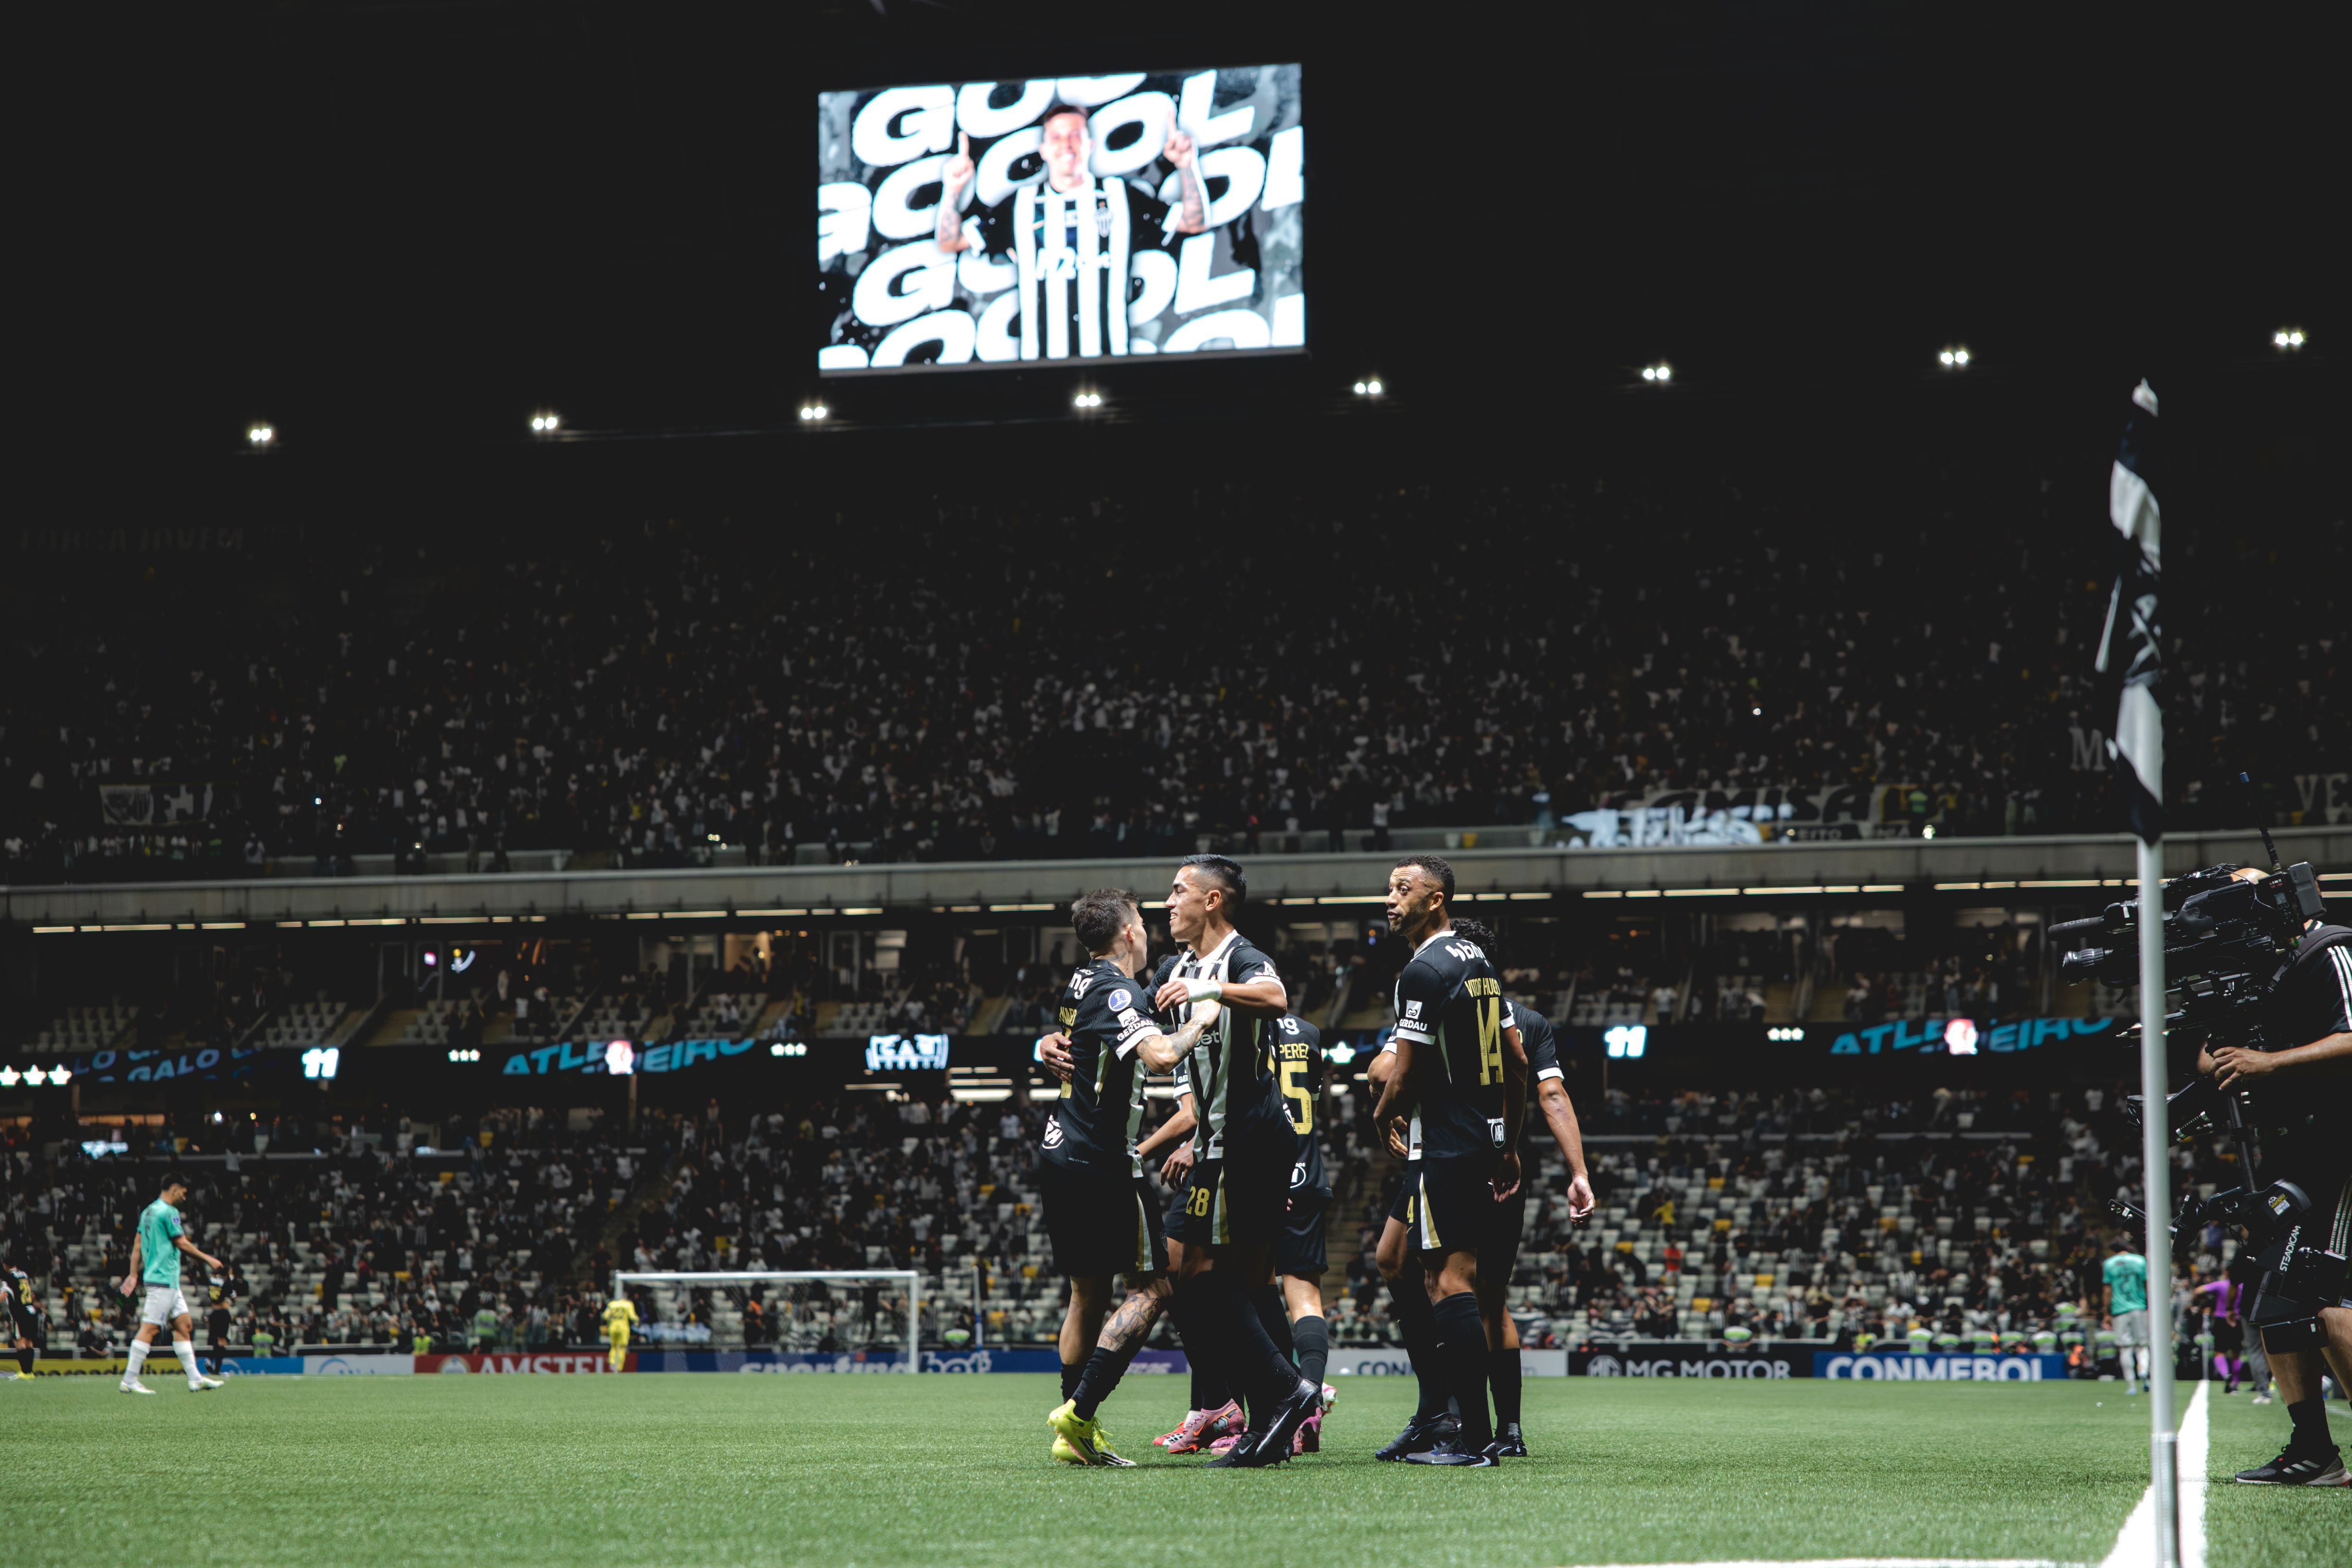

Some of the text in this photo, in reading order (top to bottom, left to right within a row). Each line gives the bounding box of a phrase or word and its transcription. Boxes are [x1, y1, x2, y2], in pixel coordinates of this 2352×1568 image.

[1464, 978, 1501, 998] VITOR HUGO
[1117, 1019, 1154, 1042] GERDAU
[1399, 1018, 1427, 1032] GERDAU
[1477, 997, 1504, 1086] 14
[1280, 1060, 1313, 1135] 5
[1185, 1185, 1210, 1217] 28
[2280, 1225, 2301, 1272] STEADICAM
[1626, 1359, 1675, 1378] MG
[1680, 1359, 1791, 1379] MOTOR
